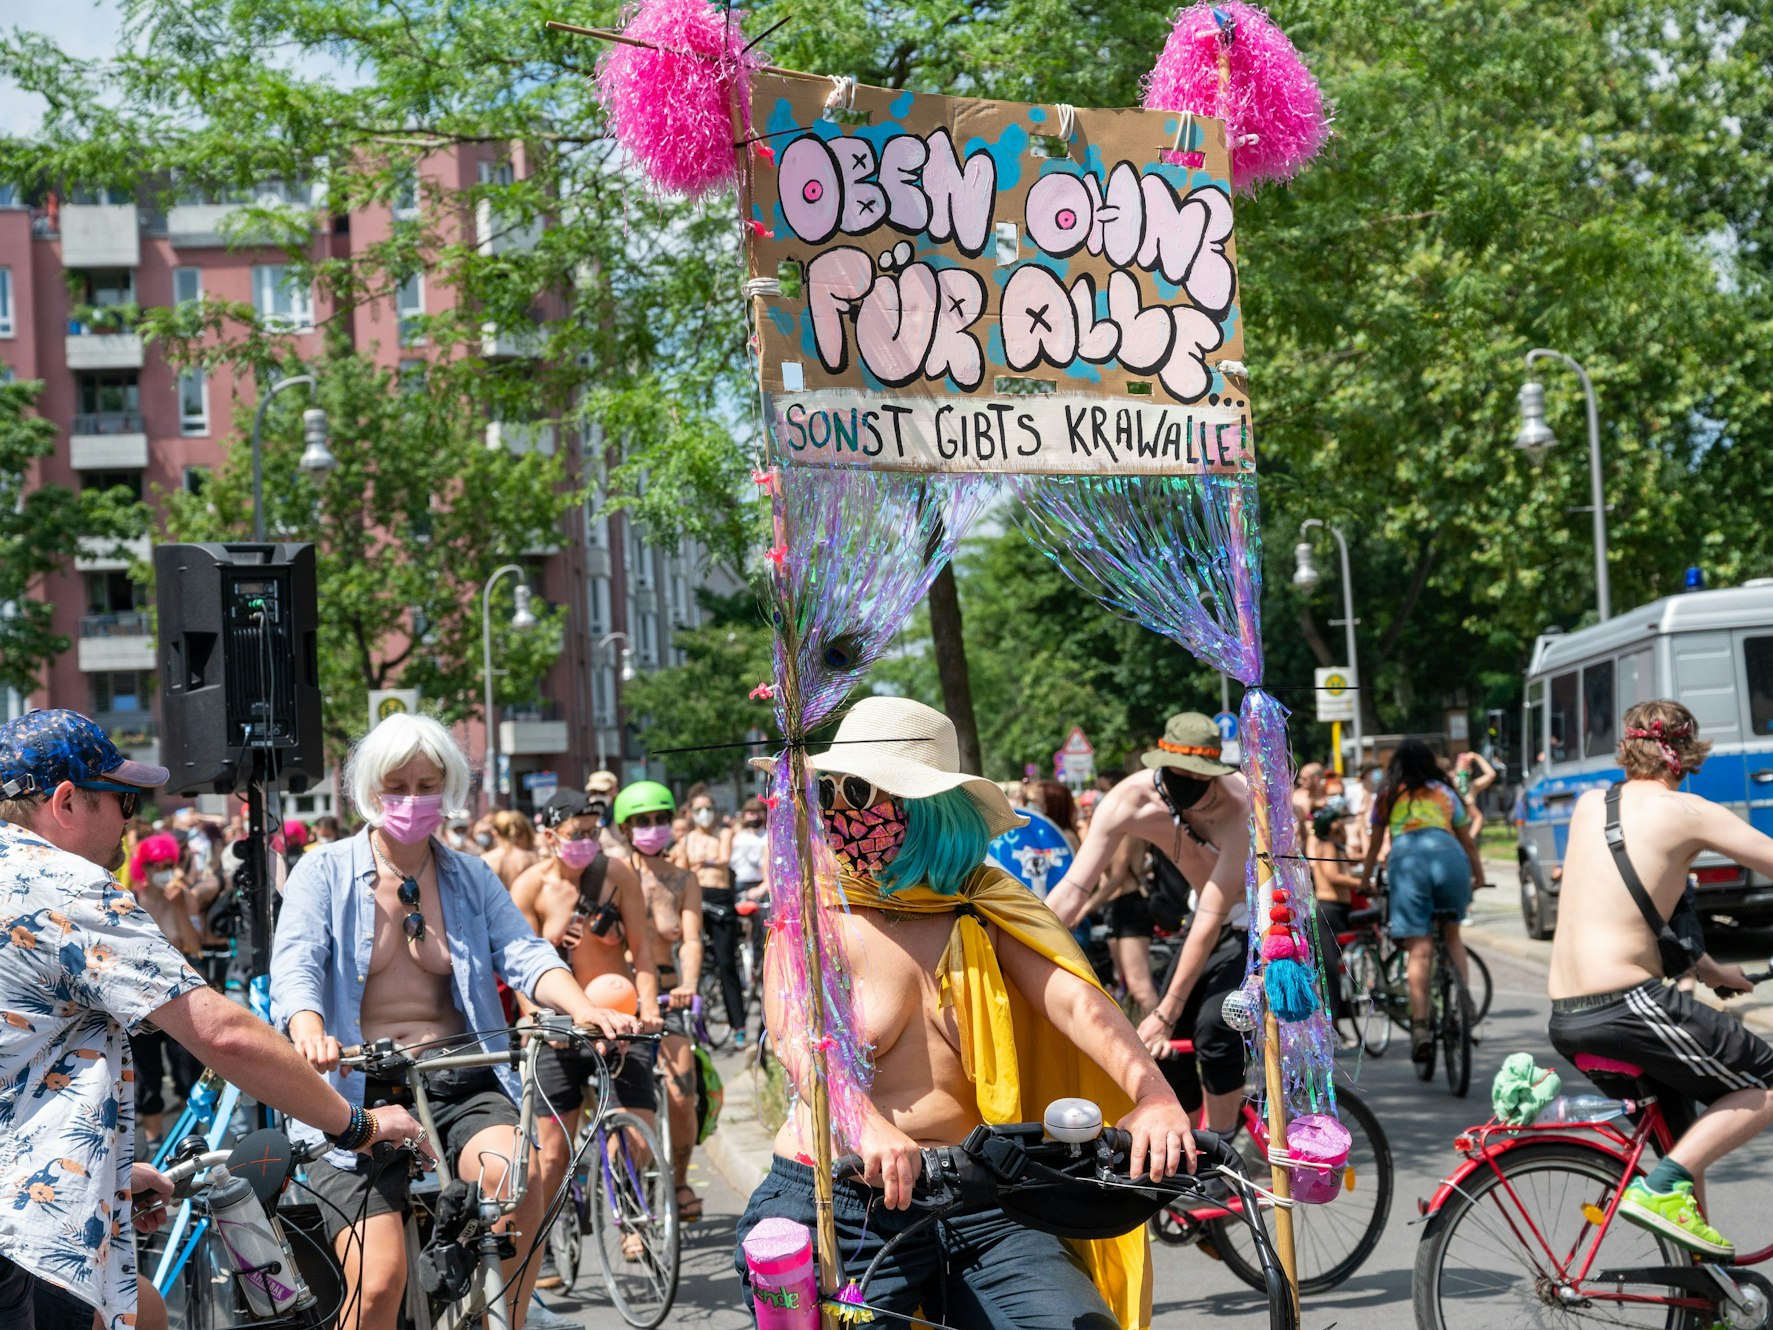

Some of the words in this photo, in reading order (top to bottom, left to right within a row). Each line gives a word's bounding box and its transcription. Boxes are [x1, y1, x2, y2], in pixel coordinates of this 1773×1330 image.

[777, 126, 998, 258] OBEN
[1025, 159, 1237, 322] OHNE
[805, 240, 989, 393] FÜR
[786, 402, 912, 457] SONST
[935, 403, 1042, 462] GIBTS
[1066, 404, 1247, 468] KRAWALLE!
